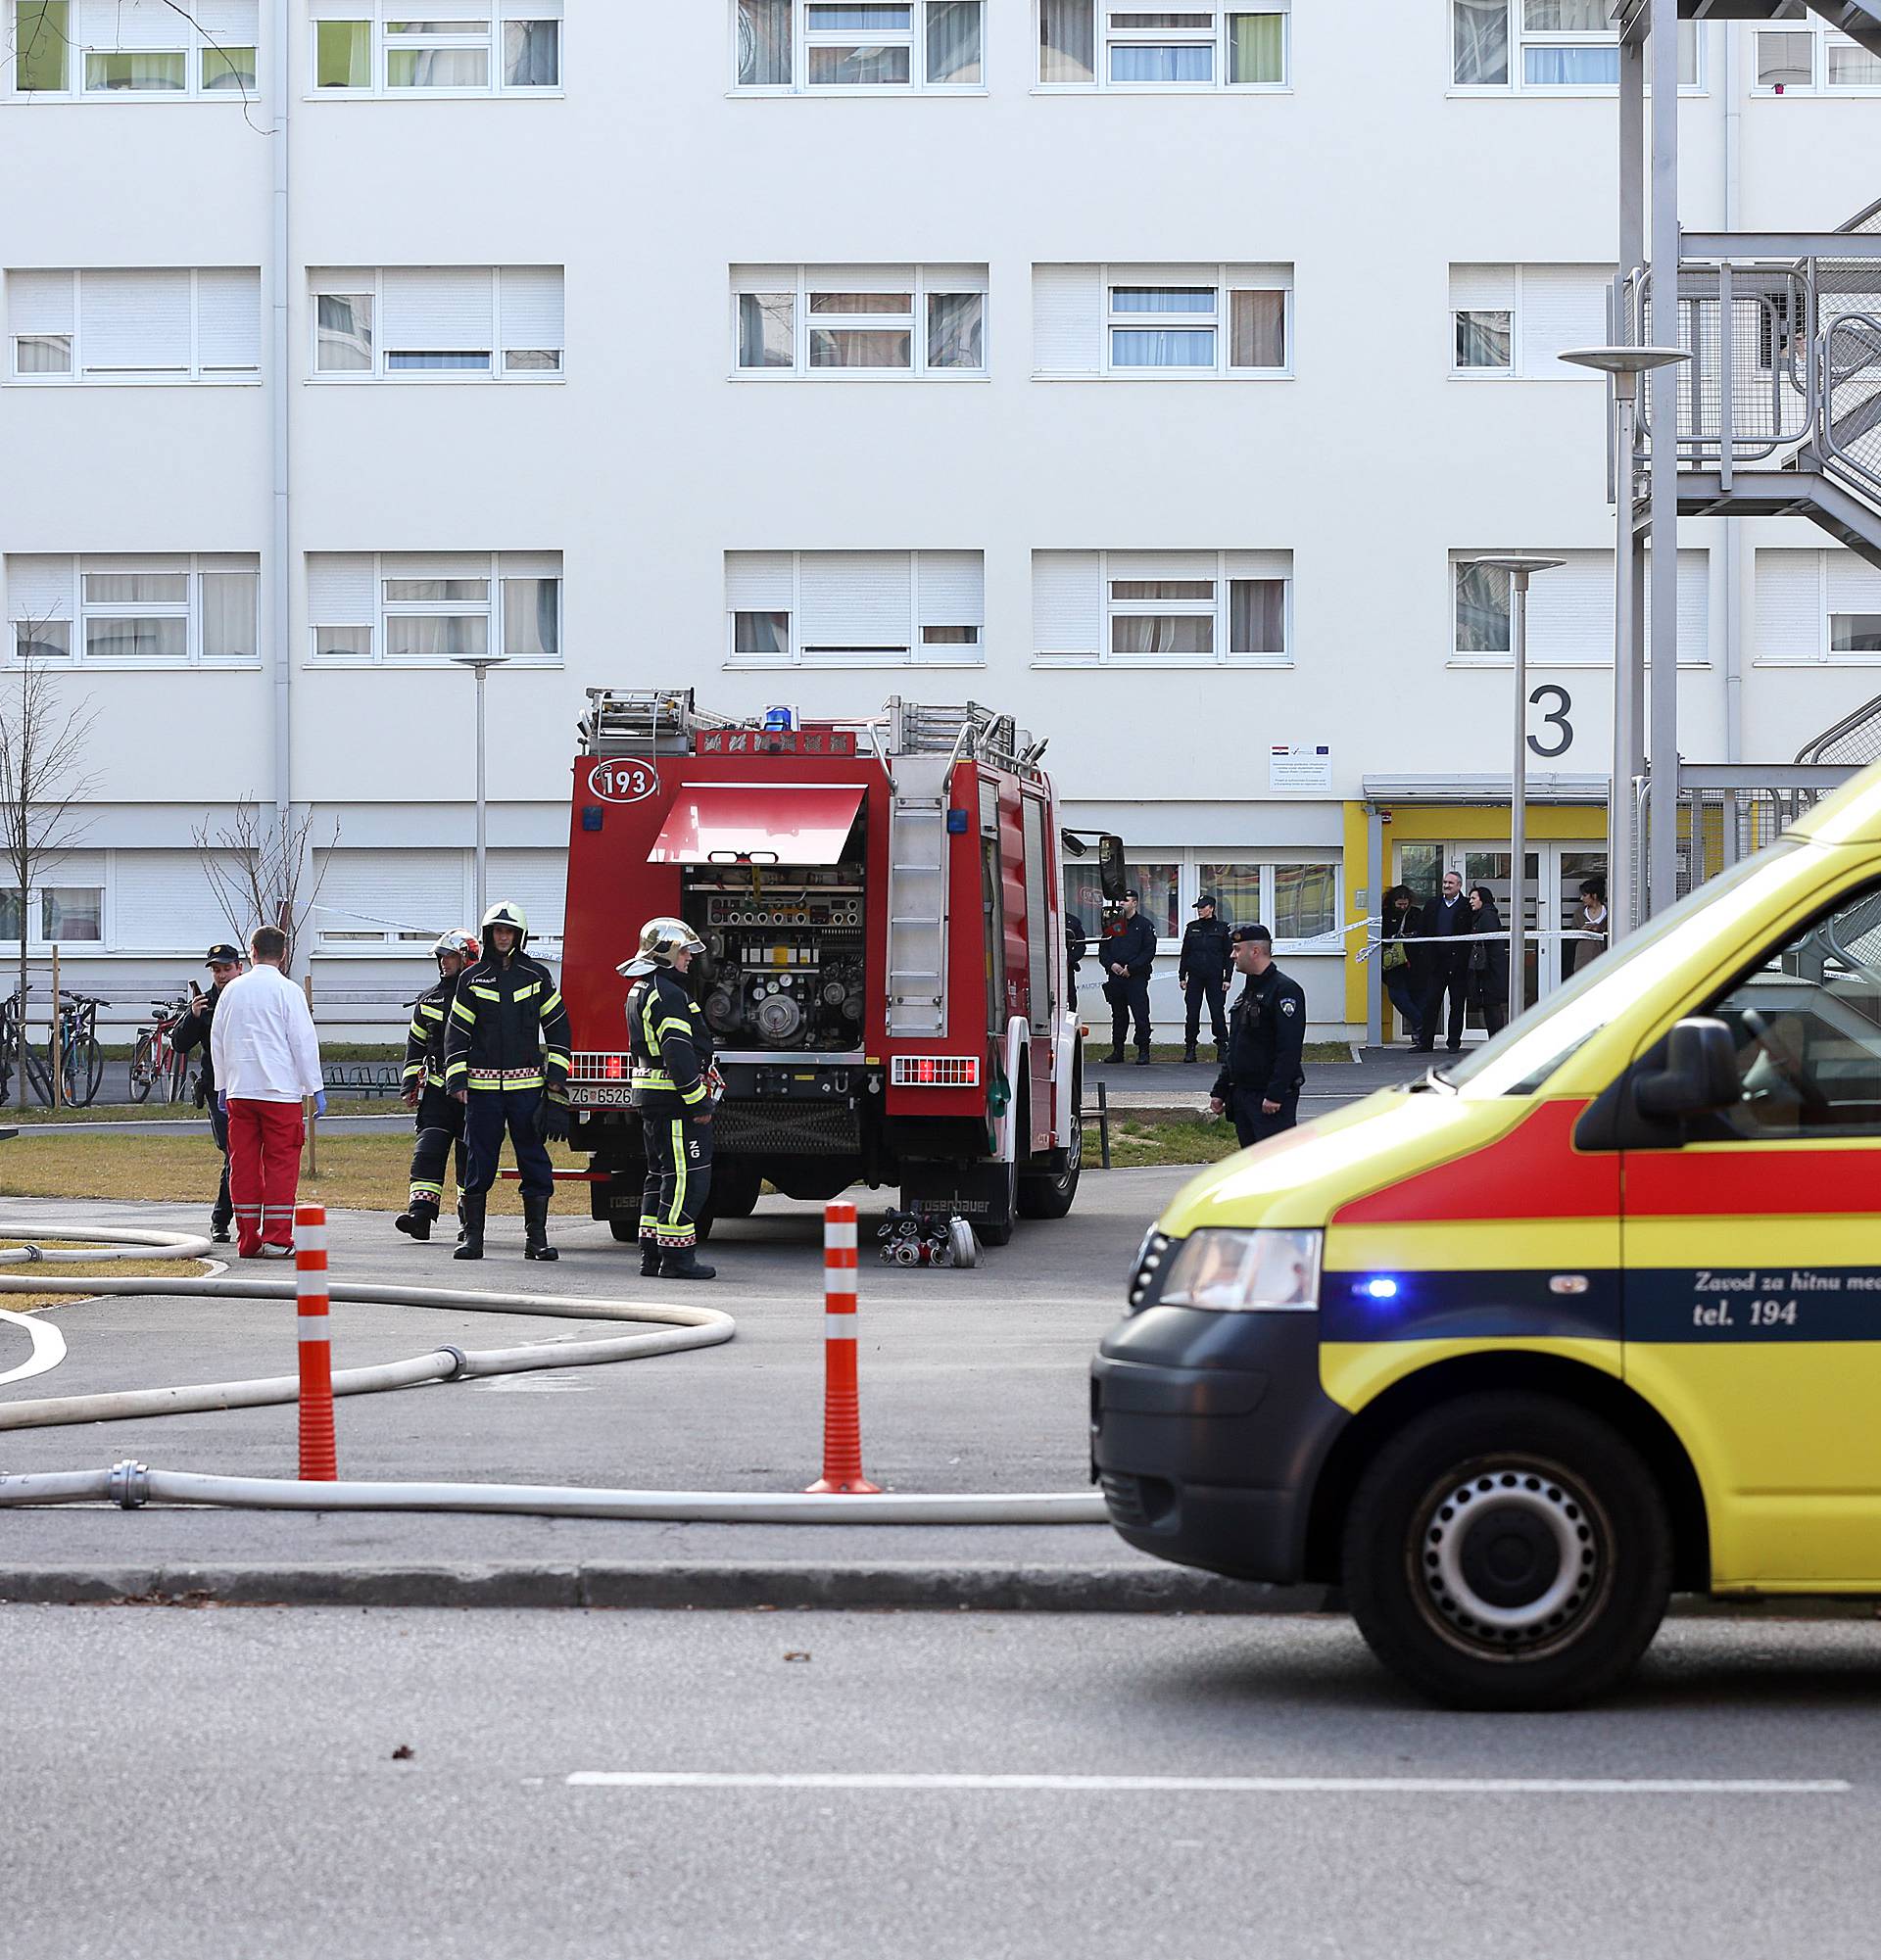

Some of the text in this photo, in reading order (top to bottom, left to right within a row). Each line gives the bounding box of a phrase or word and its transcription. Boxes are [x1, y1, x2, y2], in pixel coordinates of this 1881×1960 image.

[1526, 684, 1573, 757] 3
[603, 771, 646, 793] 193
[572, 1088, 631, 1103] ZG 6526
[608, 1195, 644, 1208] rosen
[920, 1190, 990, 1213] rosenbauer
[1694, 1270, 1756, 1291] Zavod
[1761, 1276, 1784, 1291] za
[1791, 1271, 1841, 1291] hitnu
[1693, 1299, 1798, 1326] tel. 194
